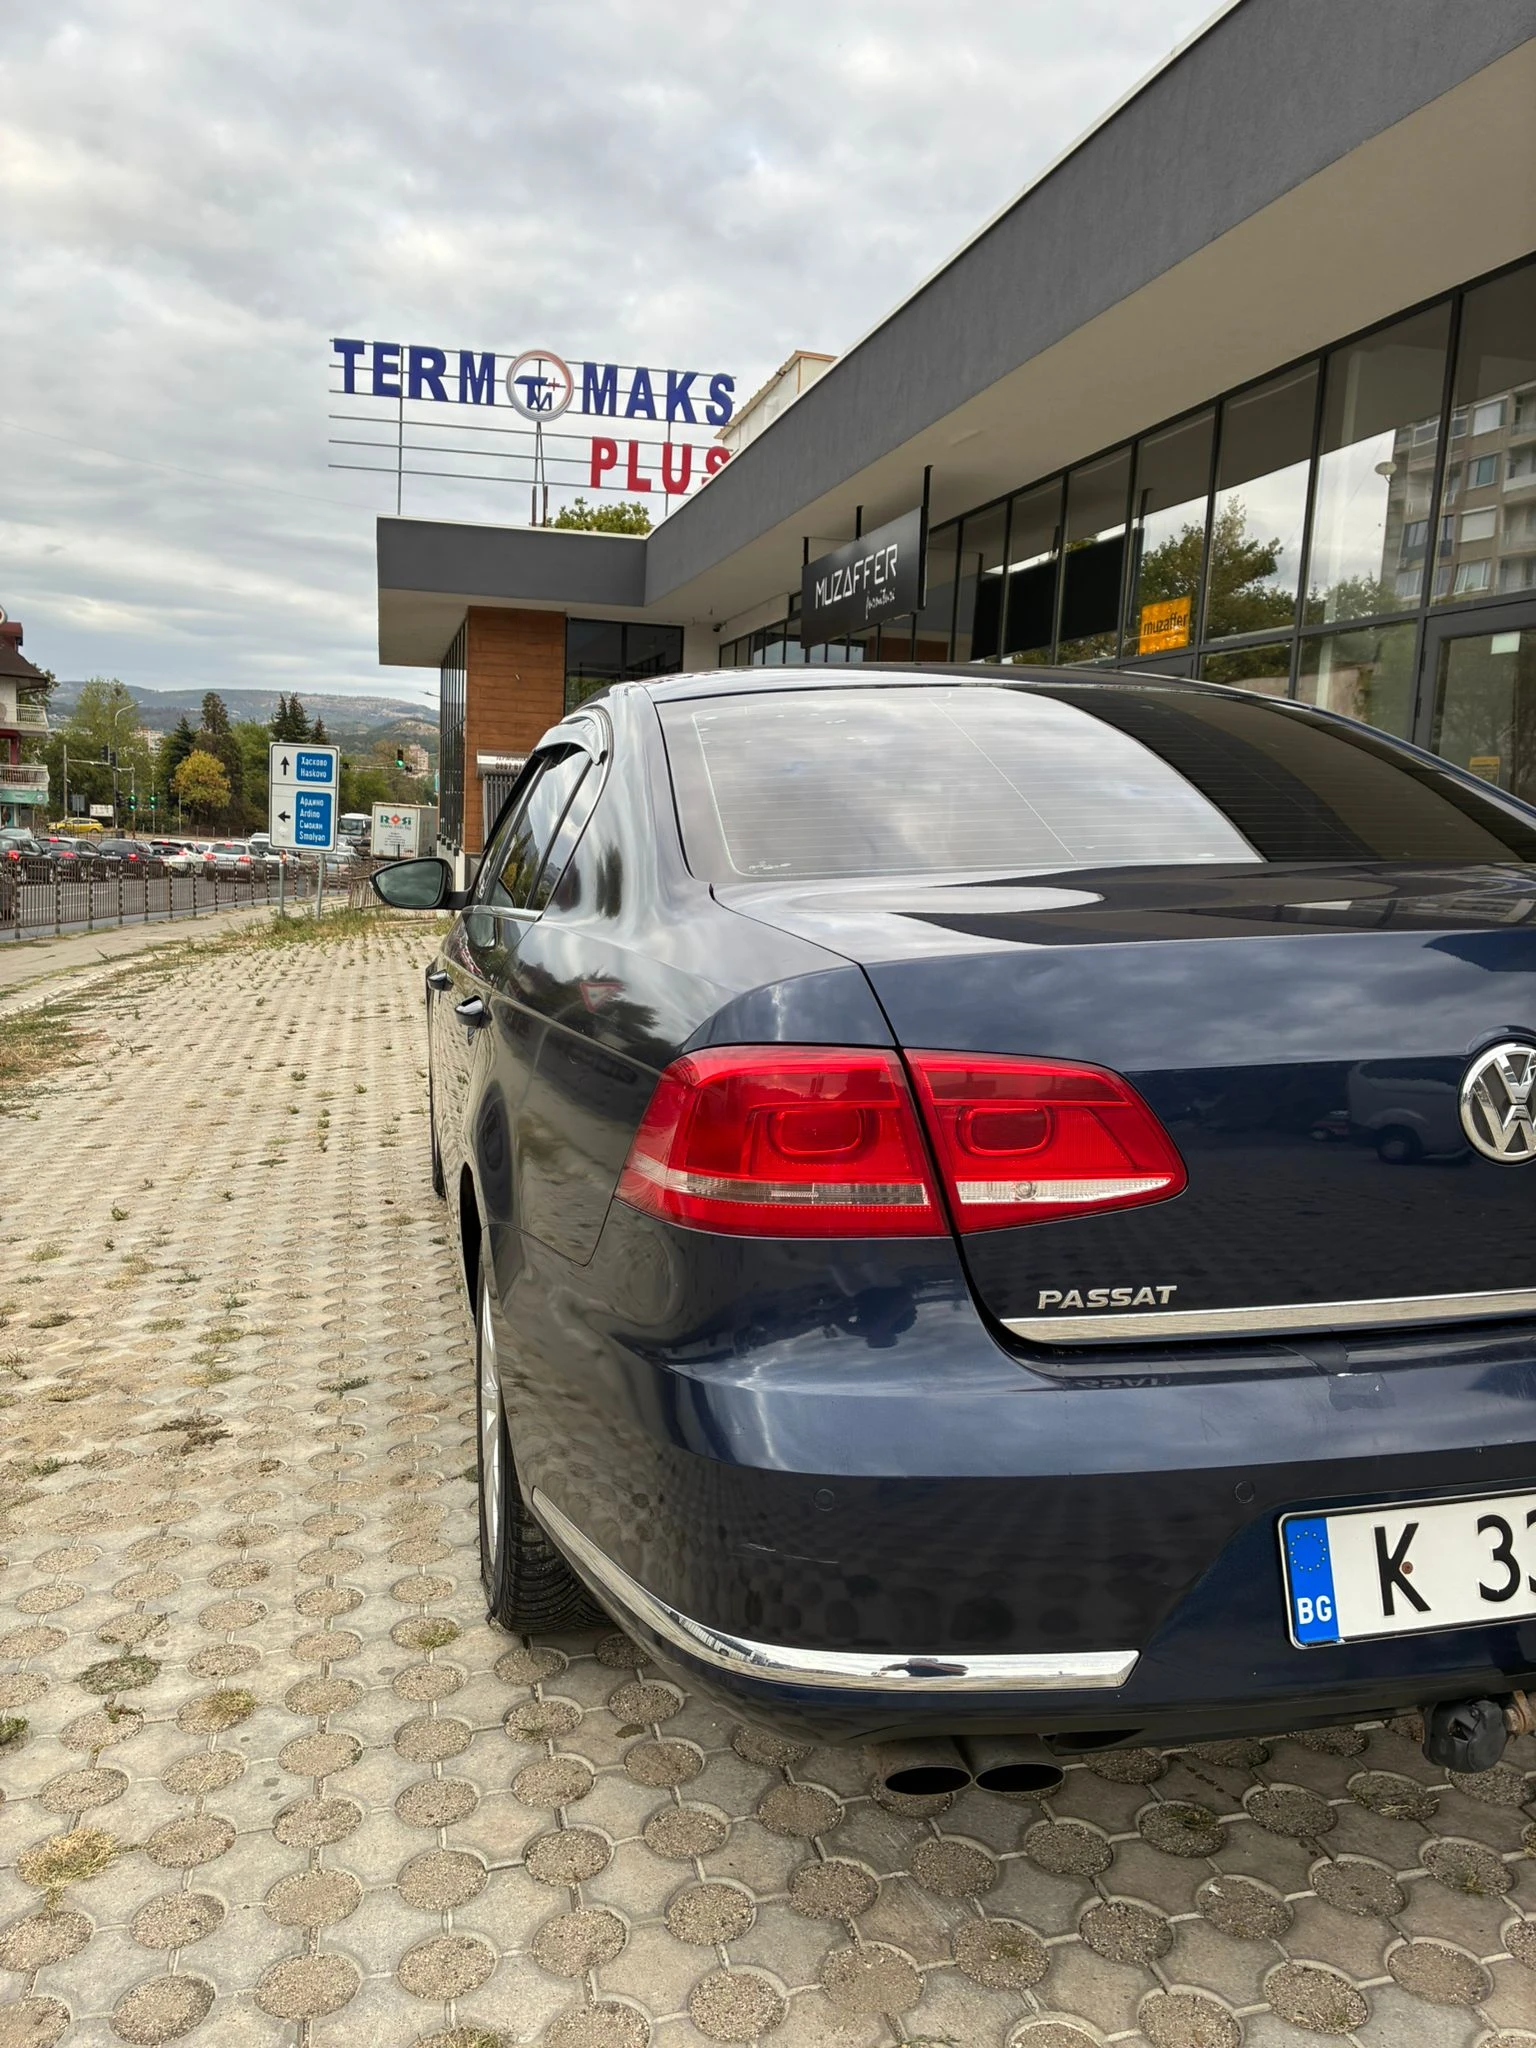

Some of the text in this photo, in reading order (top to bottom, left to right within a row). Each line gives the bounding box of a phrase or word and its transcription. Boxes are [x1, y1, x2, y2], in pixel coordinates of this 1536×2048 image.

[815, 543, 898, 609] MUZAFFER
[1143, 612, 1188, 636] muzaffer
[301, 756, 328, 767] Хасково
[300, 767, 327, 778] Haskovo
[300, 796, 324, 807] Ардино
[299, 808, 321, 818] Ardino
[299, 820, 323, 830] Смолян
[299, 830, 326, 843] Smolyan
[1037, 1285, 1178, 1310] PASSAT
[1373, 1508, 1536, 1617] K 3
[1297, 1595, 1333, 1625] BG
